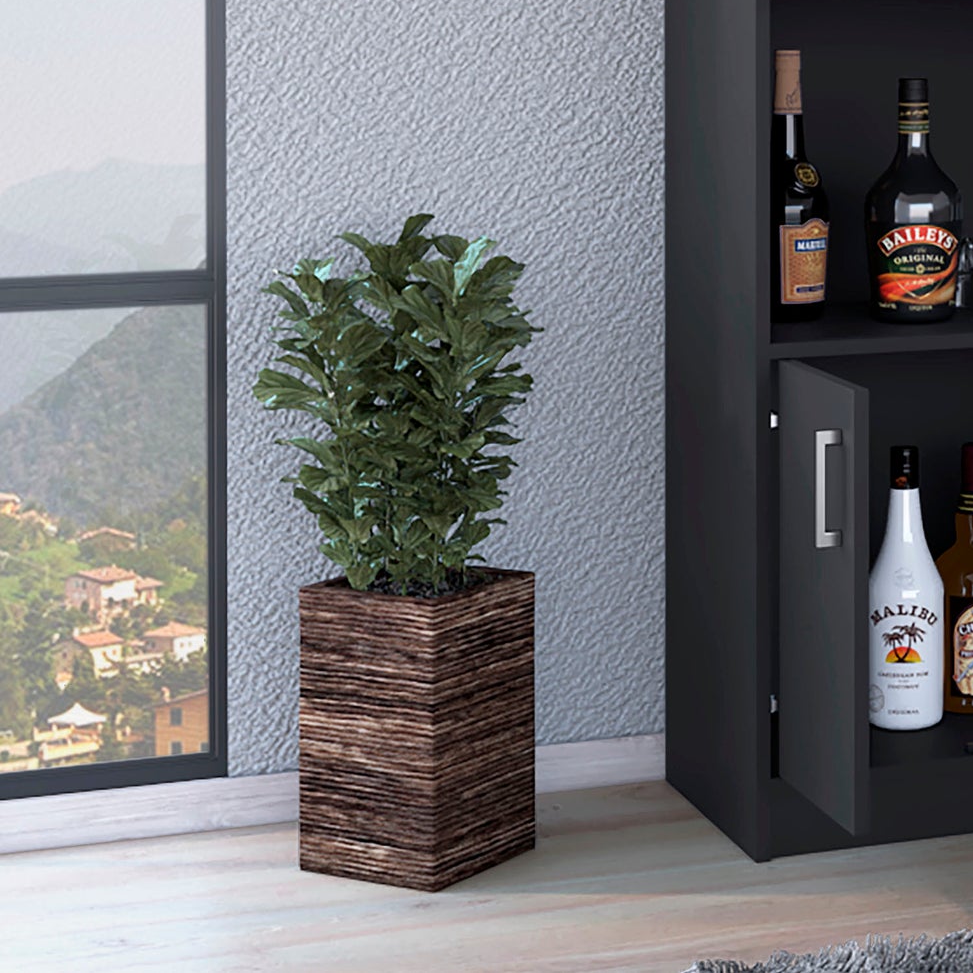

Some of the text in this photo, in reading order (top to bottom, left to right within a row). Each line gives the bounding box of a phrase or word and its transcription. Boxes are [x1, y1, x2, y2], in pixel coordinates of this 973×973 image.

[882, 227, 954, 251] BAILEYS
[893, 254, 945, 265] ORIGINAL
[870, 604, 938, 627] MALIBU
